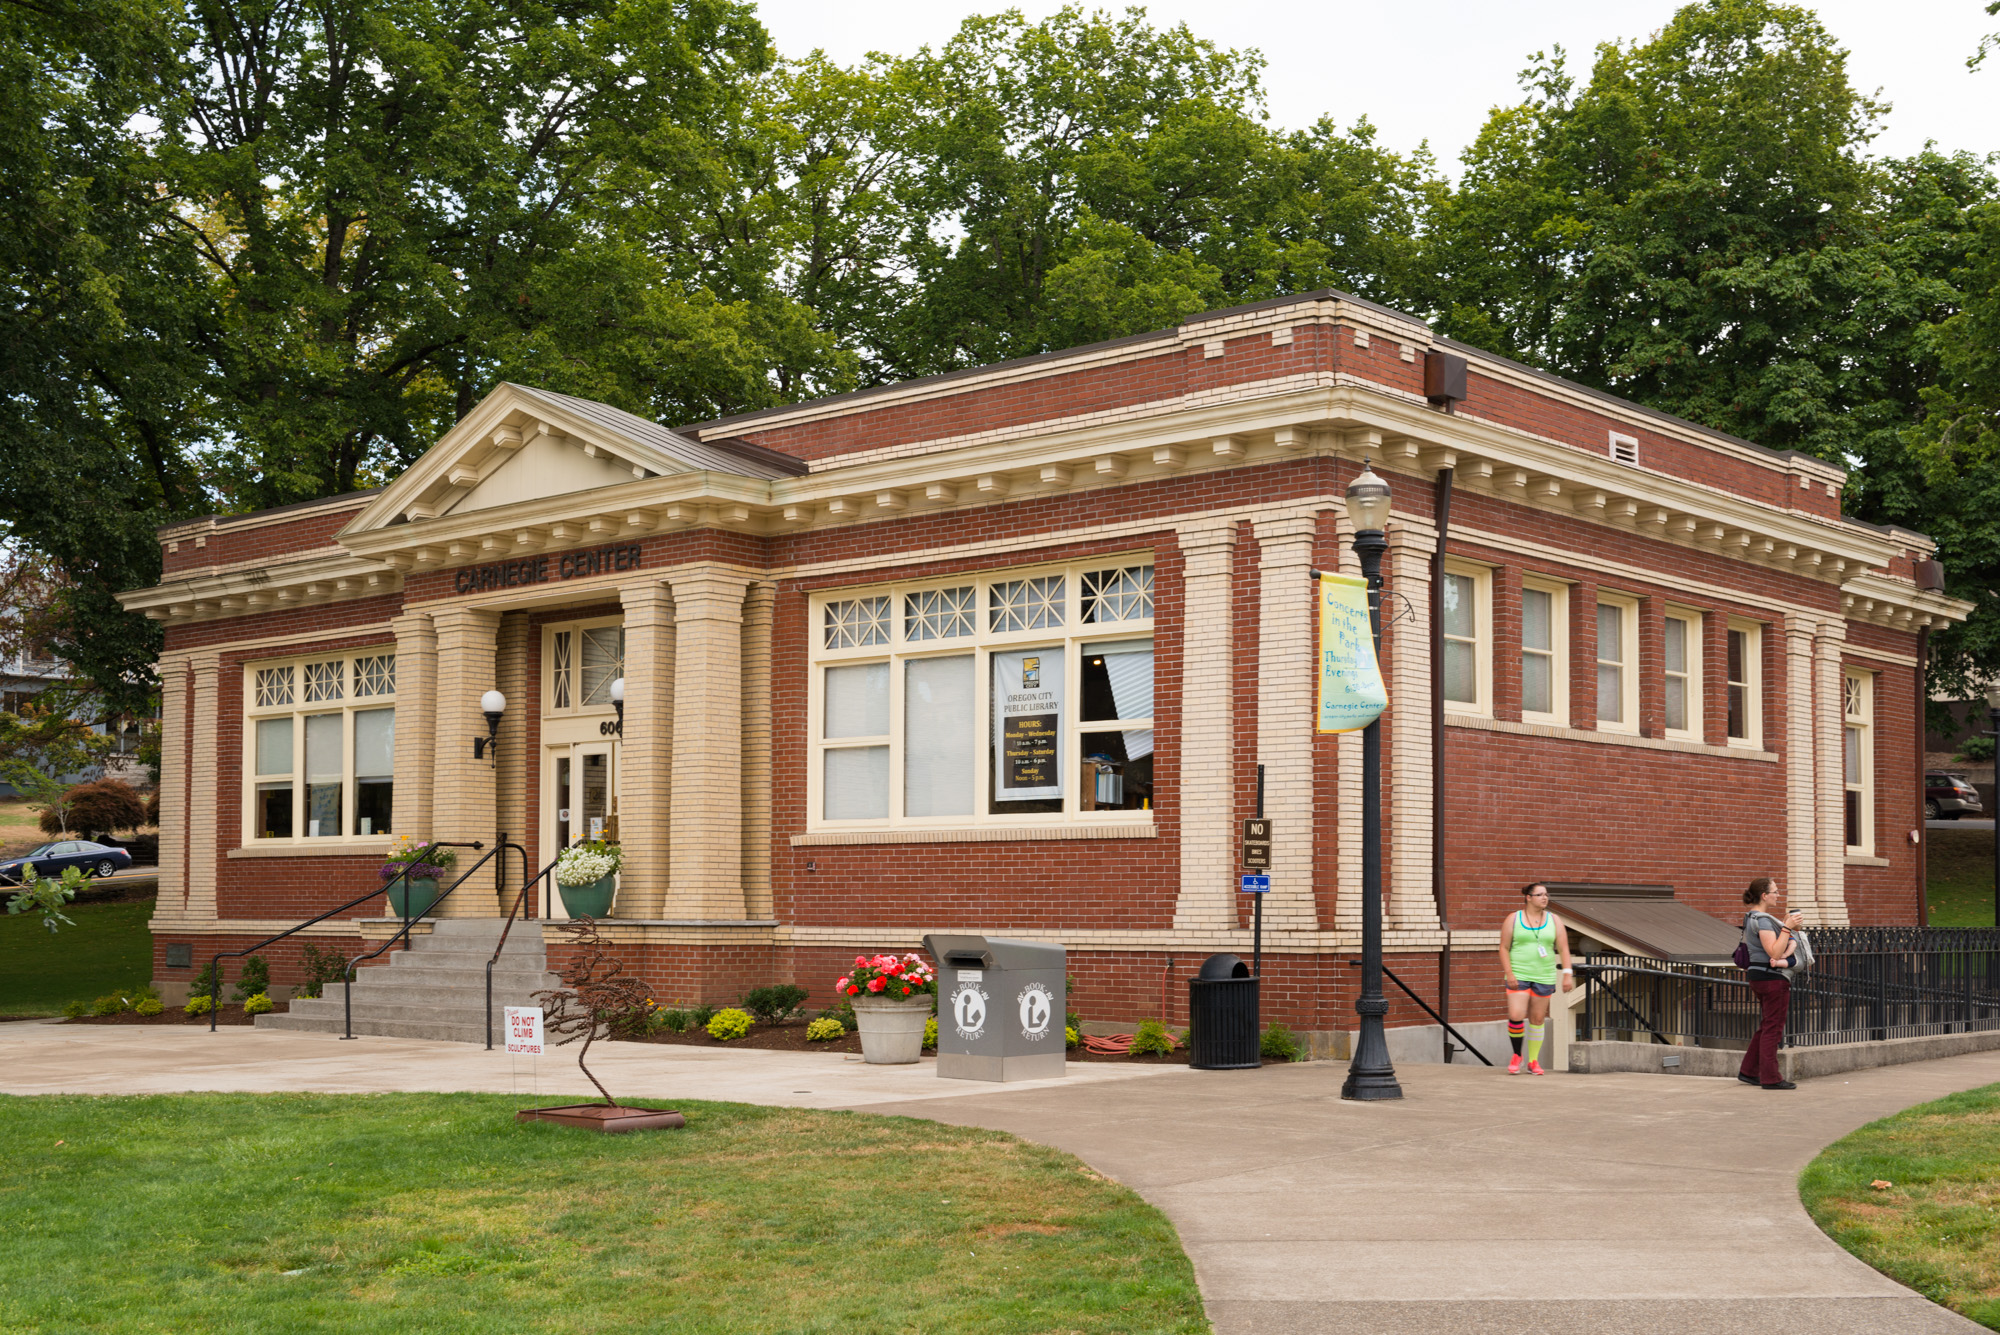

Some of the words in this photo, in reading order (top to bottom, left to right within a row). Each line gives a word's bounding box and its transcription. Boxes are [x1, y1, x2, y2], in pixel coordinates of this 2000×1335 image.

[455, 558, 549, 593] CARNEGIE
[559, 544, 642, 578] CENTER
[1327, 592, 1368, 622] Concerts
[1332, 613, 1340, 626] in
[1343, 617, 1358, 635] the
[1339, 631, 1361, 652] Park
[1008, 694, 1037, 702] OREGON
[1038, 692, 1053, 700] CITY
[1004, 704, 1028, 713] PUBLIC
[1029, 702, 1059, 711] LIBRARY
[1325, 701, 1359, 712] Carnegie
[1360, 701, 1385, 710] Center
[1251, 823, 1264, 835] NO
[959, 982, 981, 992] BOOK
[1024, 982, 1046, 992] BOOK
[512, 1016, 520, 1026] DO
[521, 1017, 535, 1026] NOT
[514, 1028, 533, 1038] CLIMB
[955, 1025, 985, 1040] RETURN
[1021, 1026, 1050, 1042] RETURN
[508, 1044, 541, 1053] SCULPTURES
